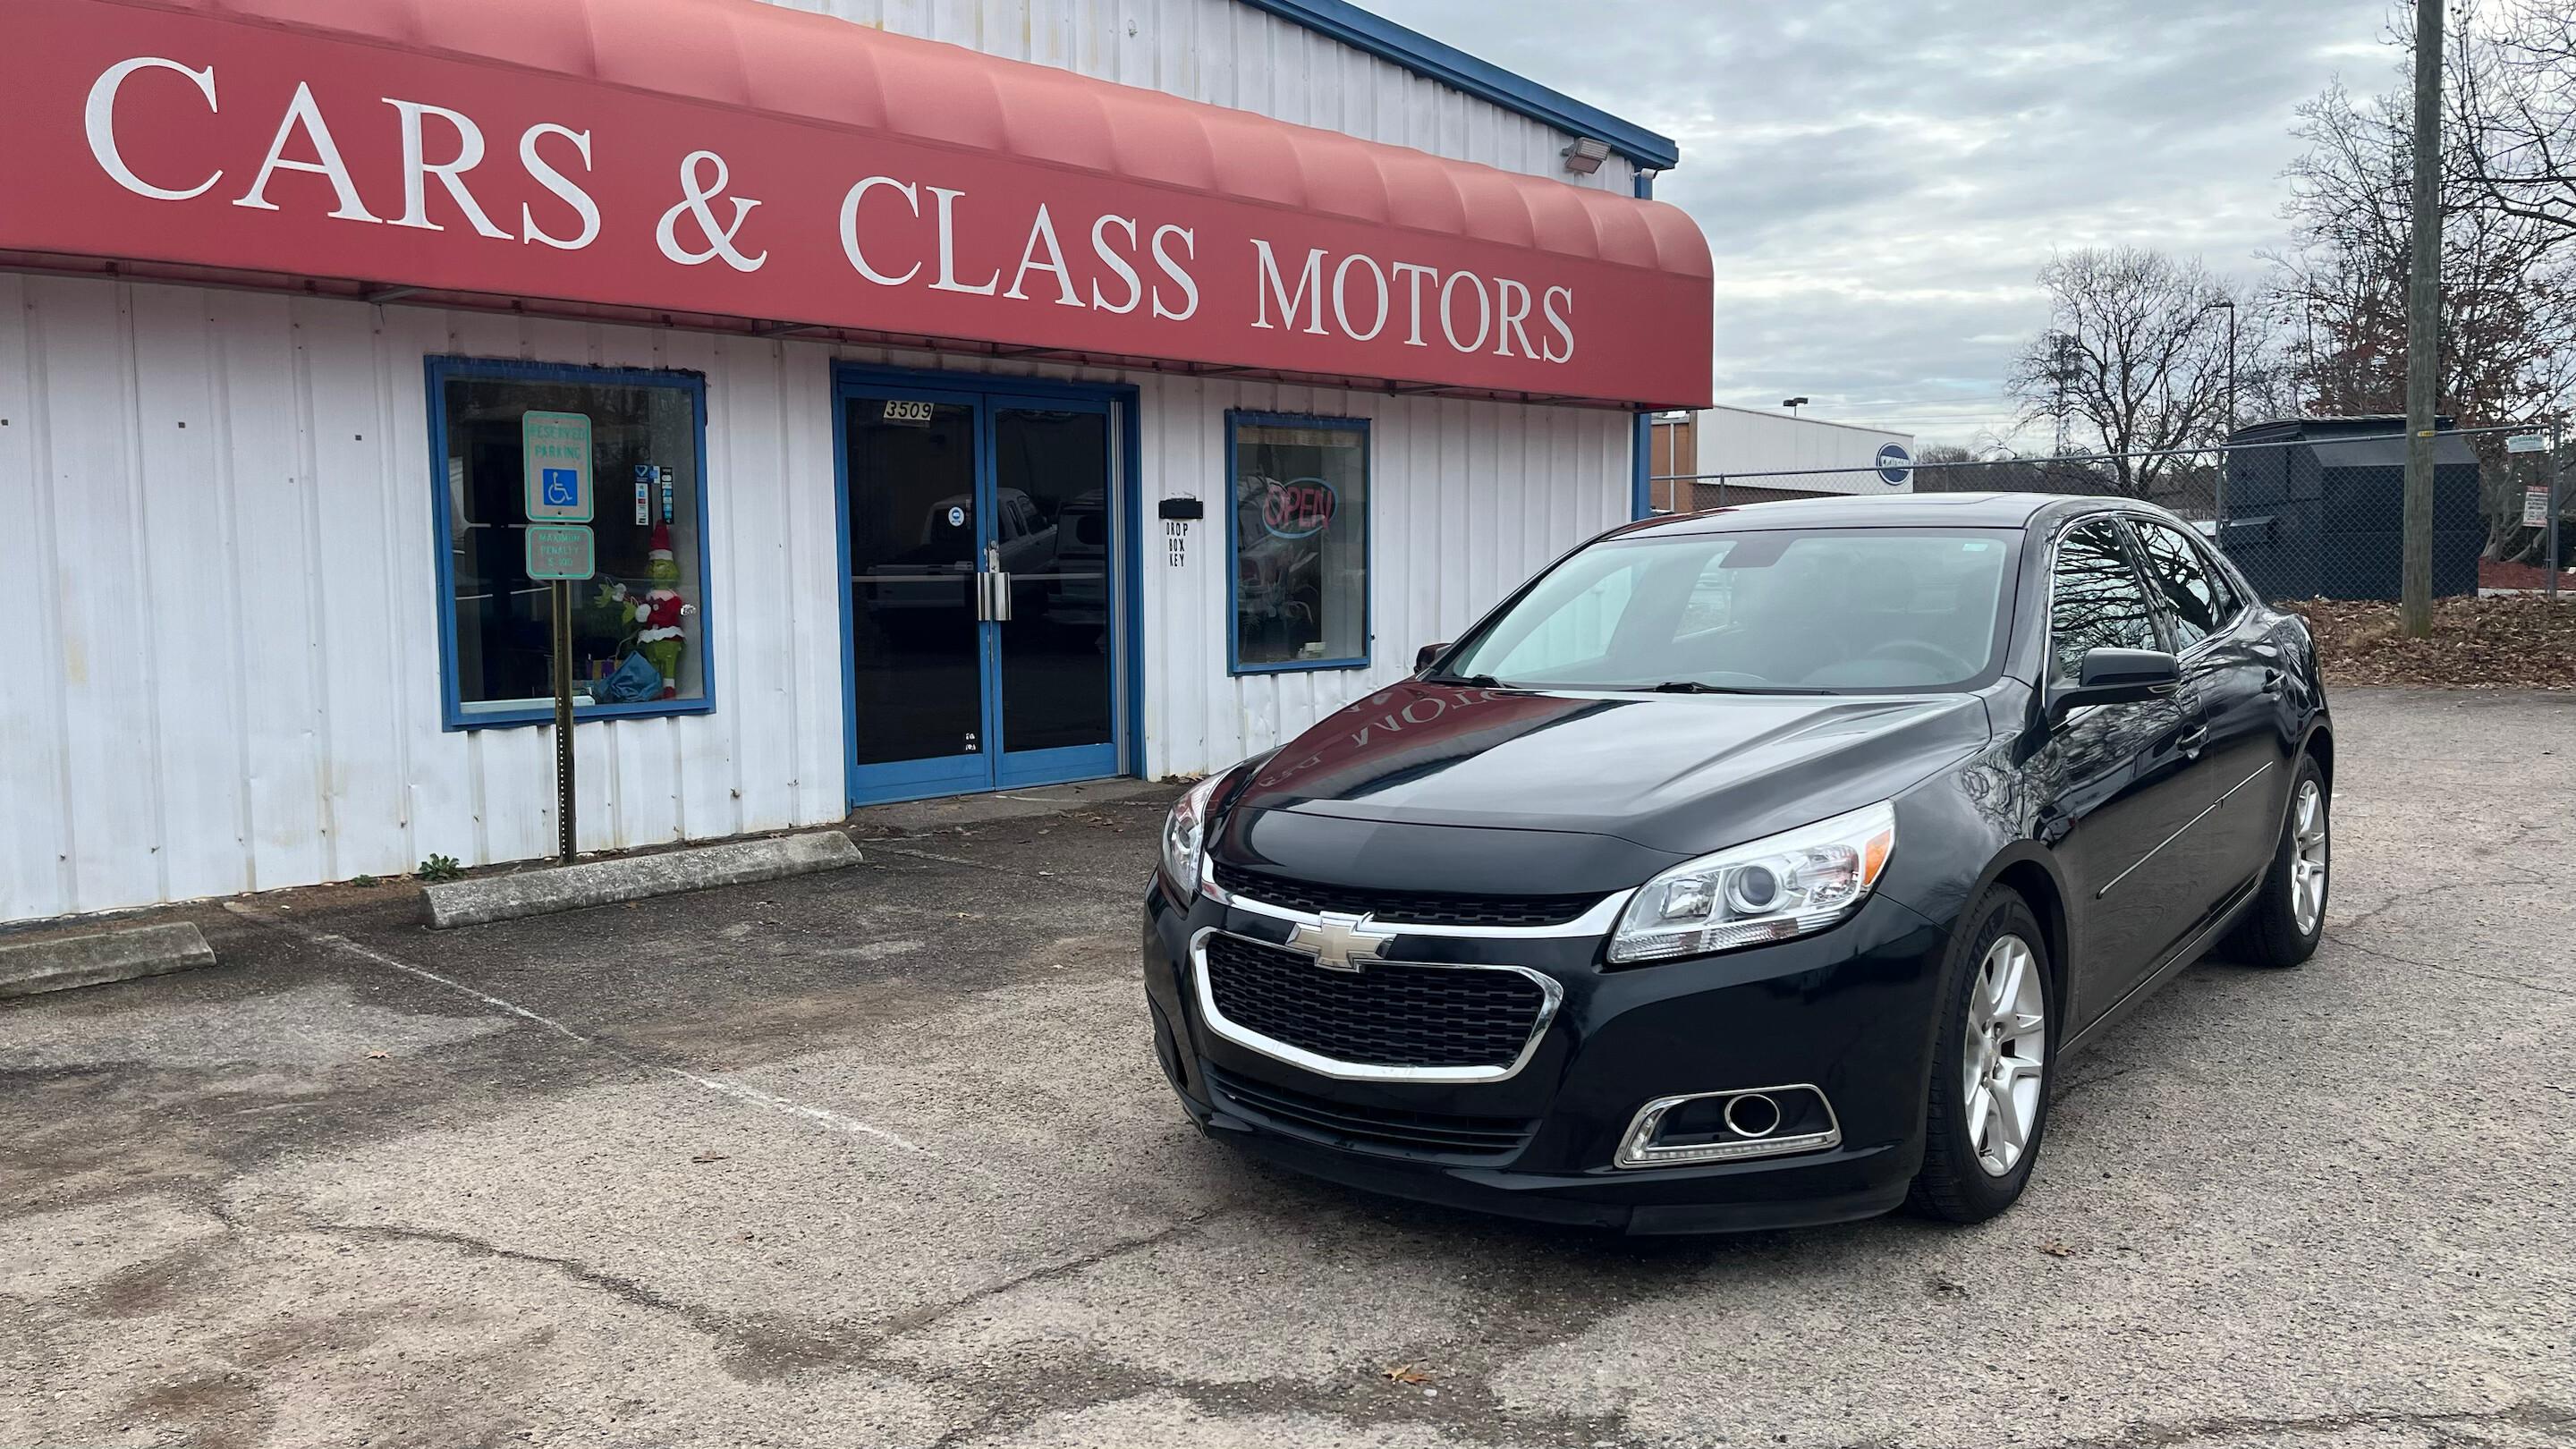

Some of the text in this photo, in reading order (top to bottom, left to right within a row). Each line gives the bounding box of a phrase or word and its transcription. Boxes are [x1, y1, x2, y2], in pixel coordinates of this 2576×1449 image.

[85, 57, 1575, 363] CARS & CLASS MOTORS
[886, 402, 931, 419] 3509
[535, 445, 580, 459] PARKING
[1265, 486, 1333, 530] OPEN
[1166, 521, 1188, 537] DROP
[1169, 538, 1185, 552] BOX
[1169, 554, 1184, 567] KEY
